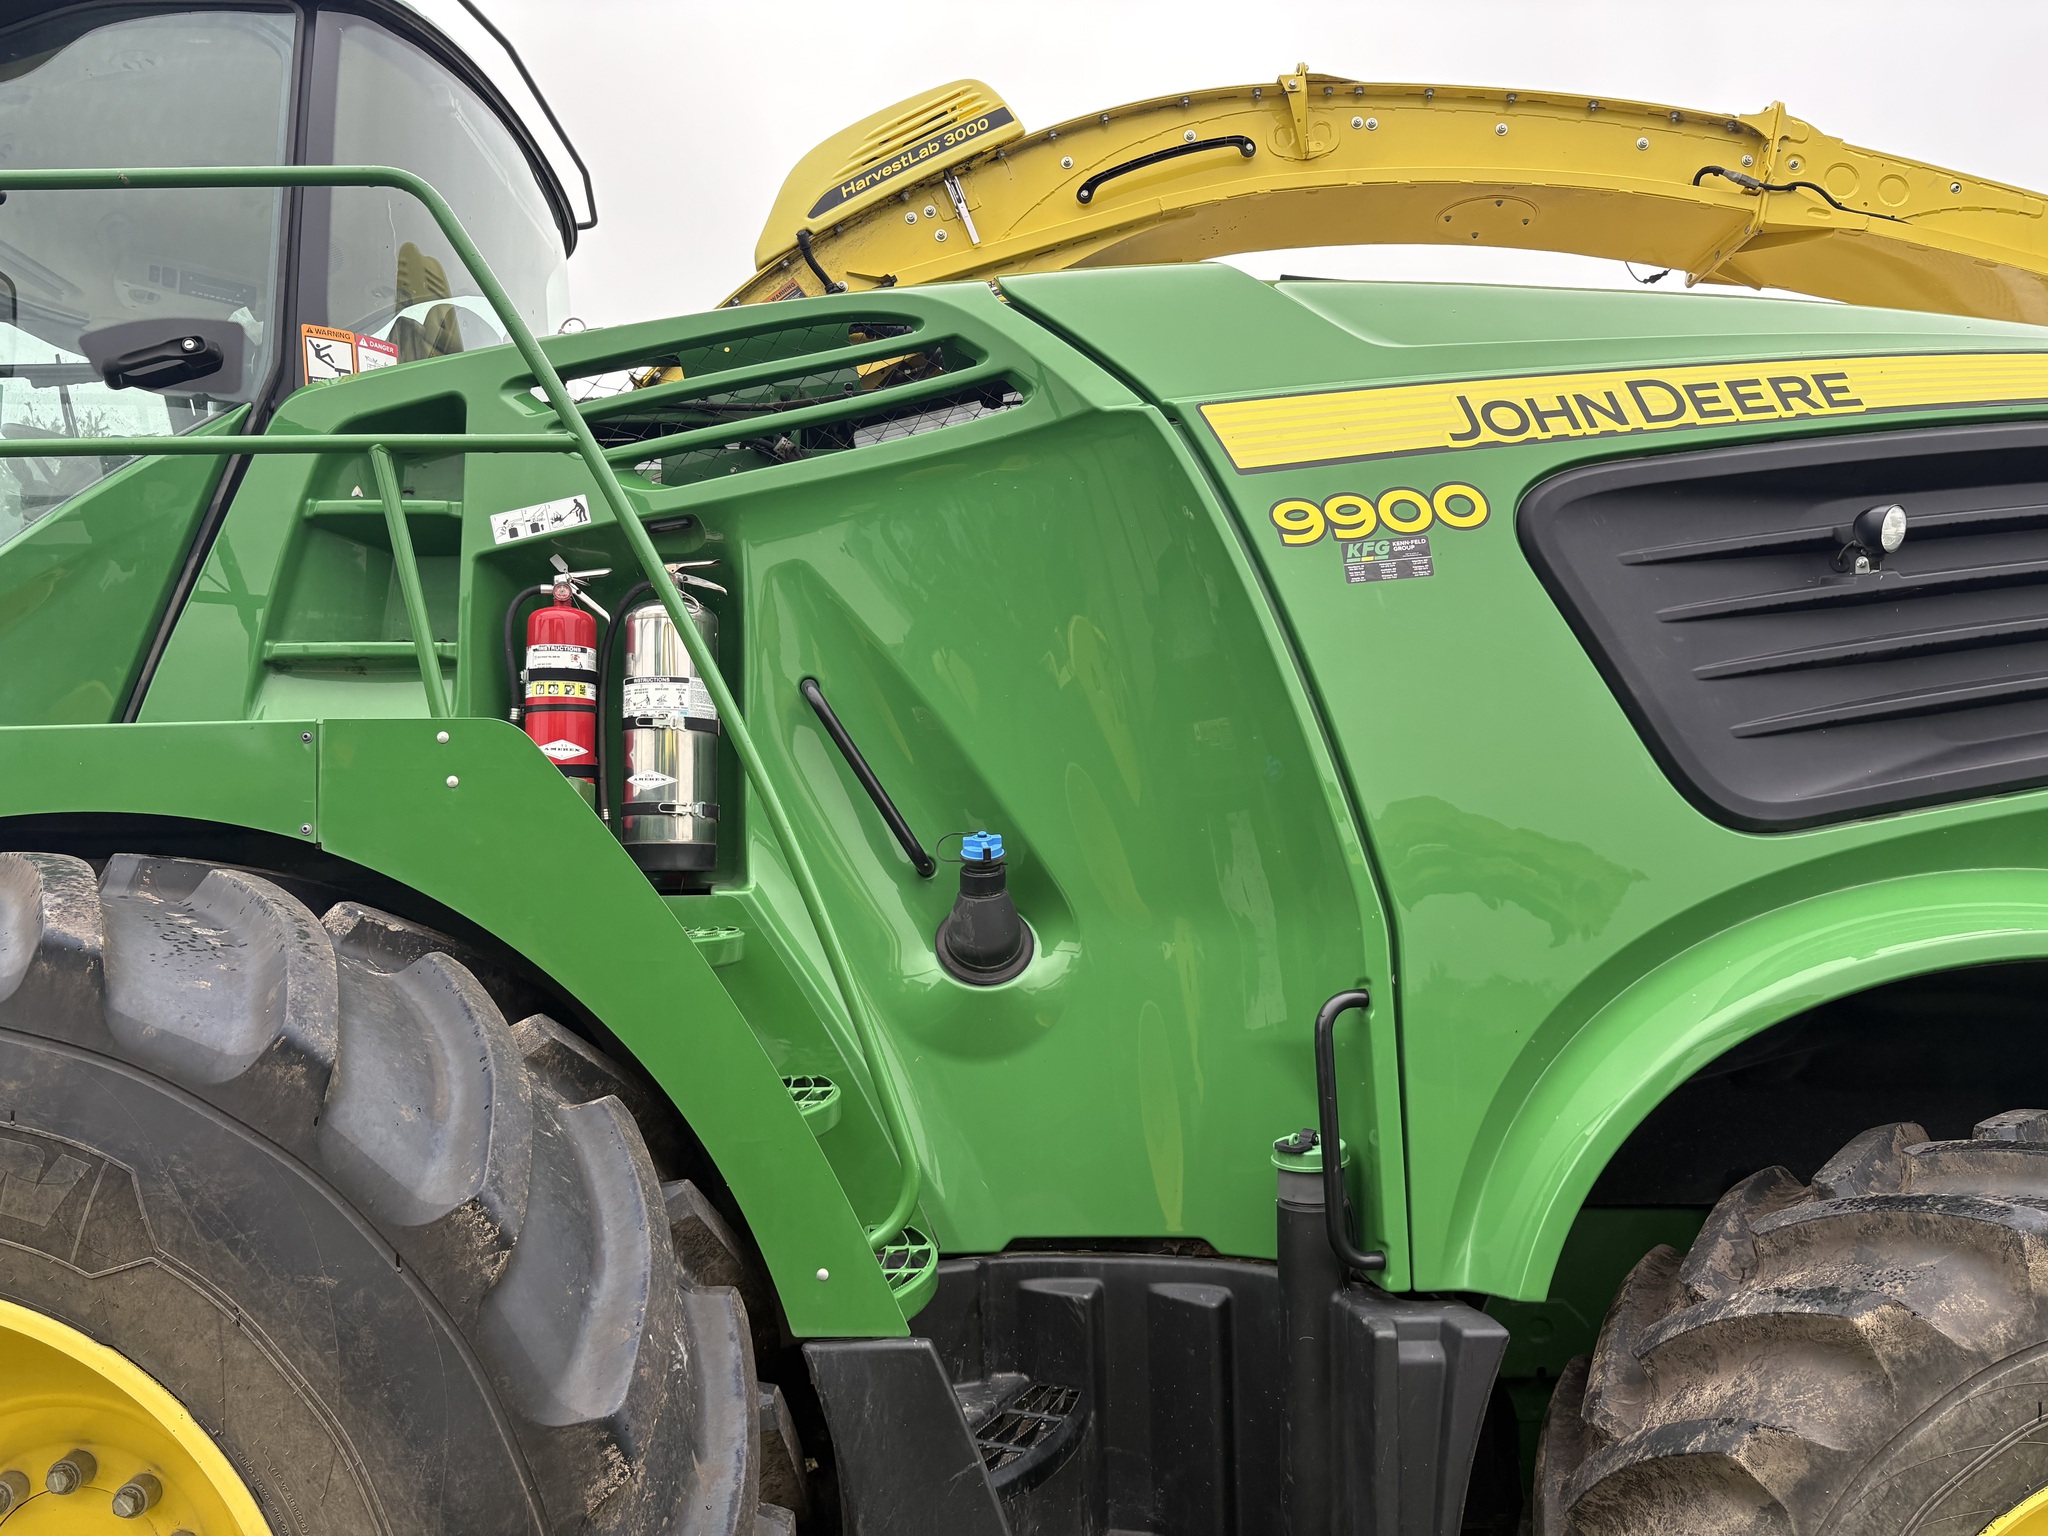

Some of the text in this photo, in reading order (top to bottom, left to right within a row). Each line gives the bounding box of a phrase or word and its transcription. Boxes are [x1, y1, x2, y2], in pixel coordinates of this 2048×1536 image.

[841, 118, 989, 198] HarvestLab 3000
[315, 328, 350, 340] WARNING
[369, 340, 394, 354] DANGER
[1449, 371, 1864, 441] JOHN DEERE
[1270, 482, 1490, 546] 9900
[1347, 540, 1390, 558] KFG
[1392, 538, 1426, 547] KENN-FELD
[1393, 544, 1416, 552] GROUP
